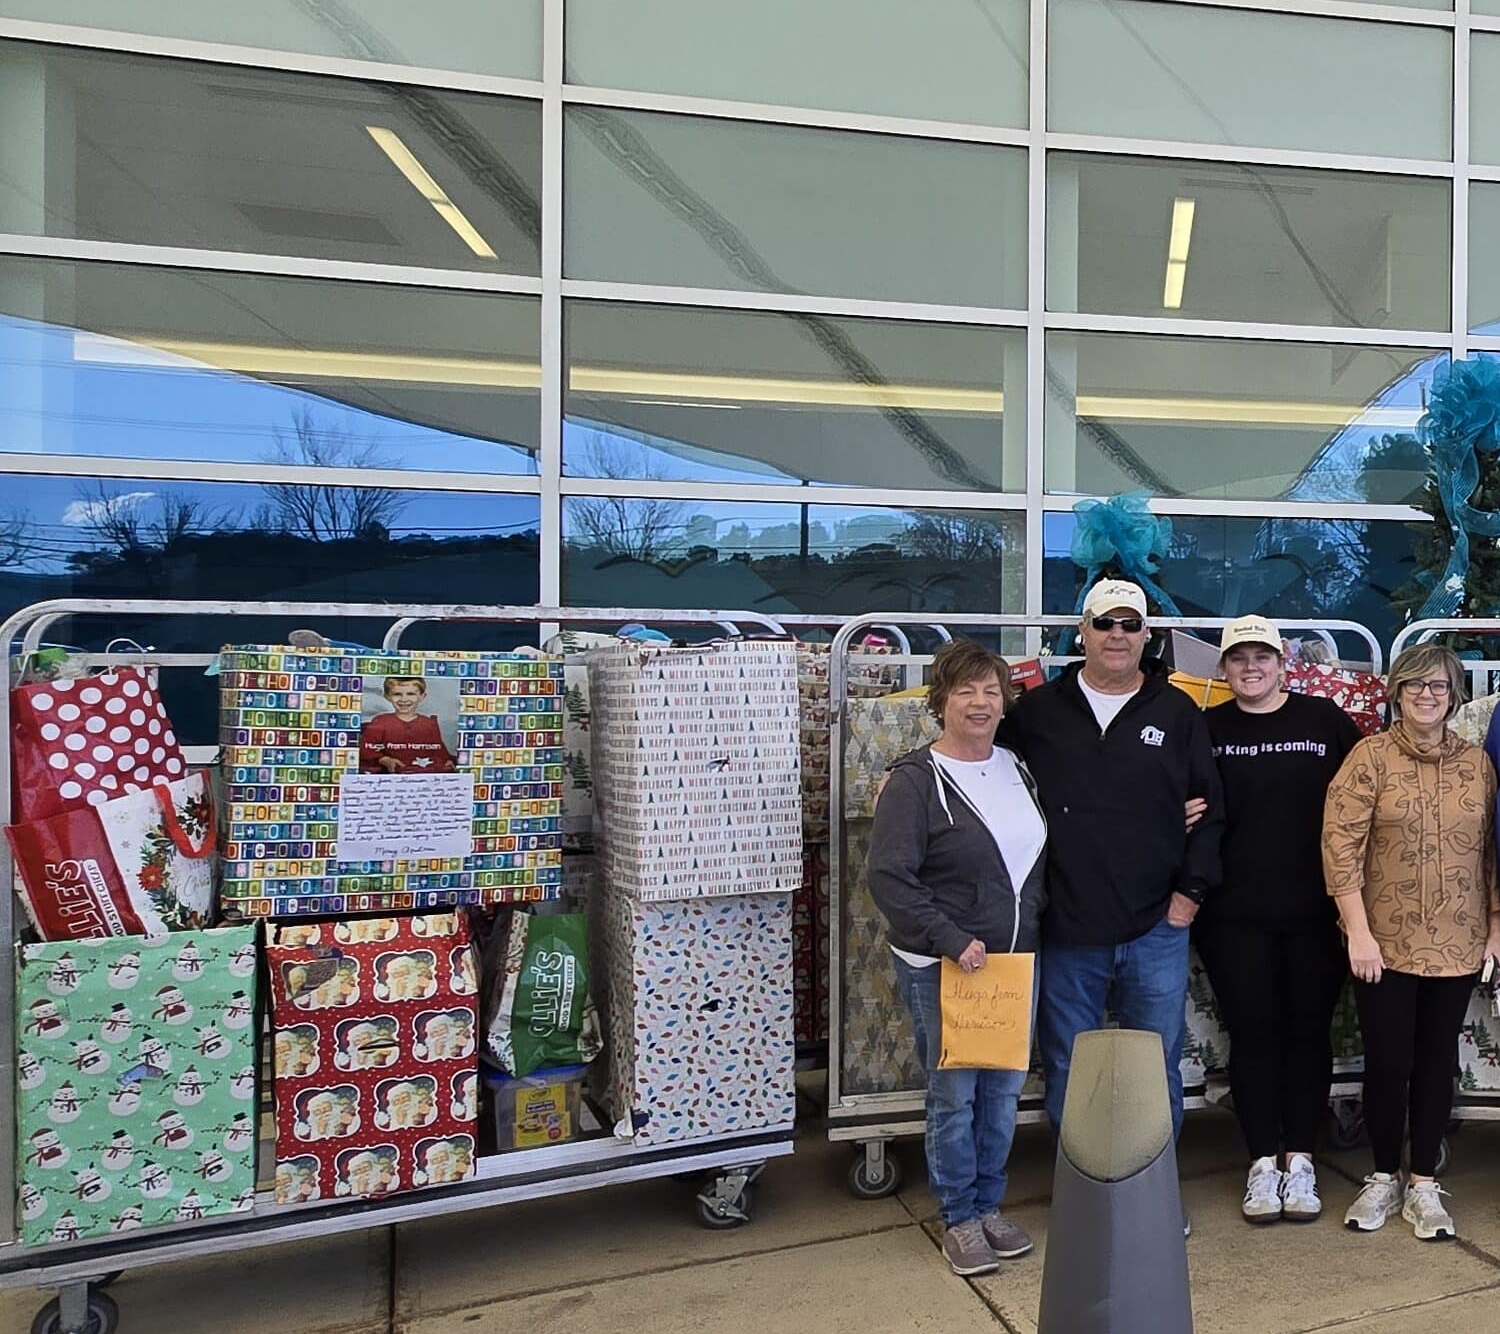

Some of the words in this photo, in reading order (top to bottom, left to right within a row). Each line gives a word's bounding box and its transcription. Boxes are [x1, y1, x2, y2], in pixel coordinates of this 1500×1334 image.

[1225, 745, 1258, 757] King
[1261, 743, 1274, 753] is
[1275, 739, 1326, 757] coming
